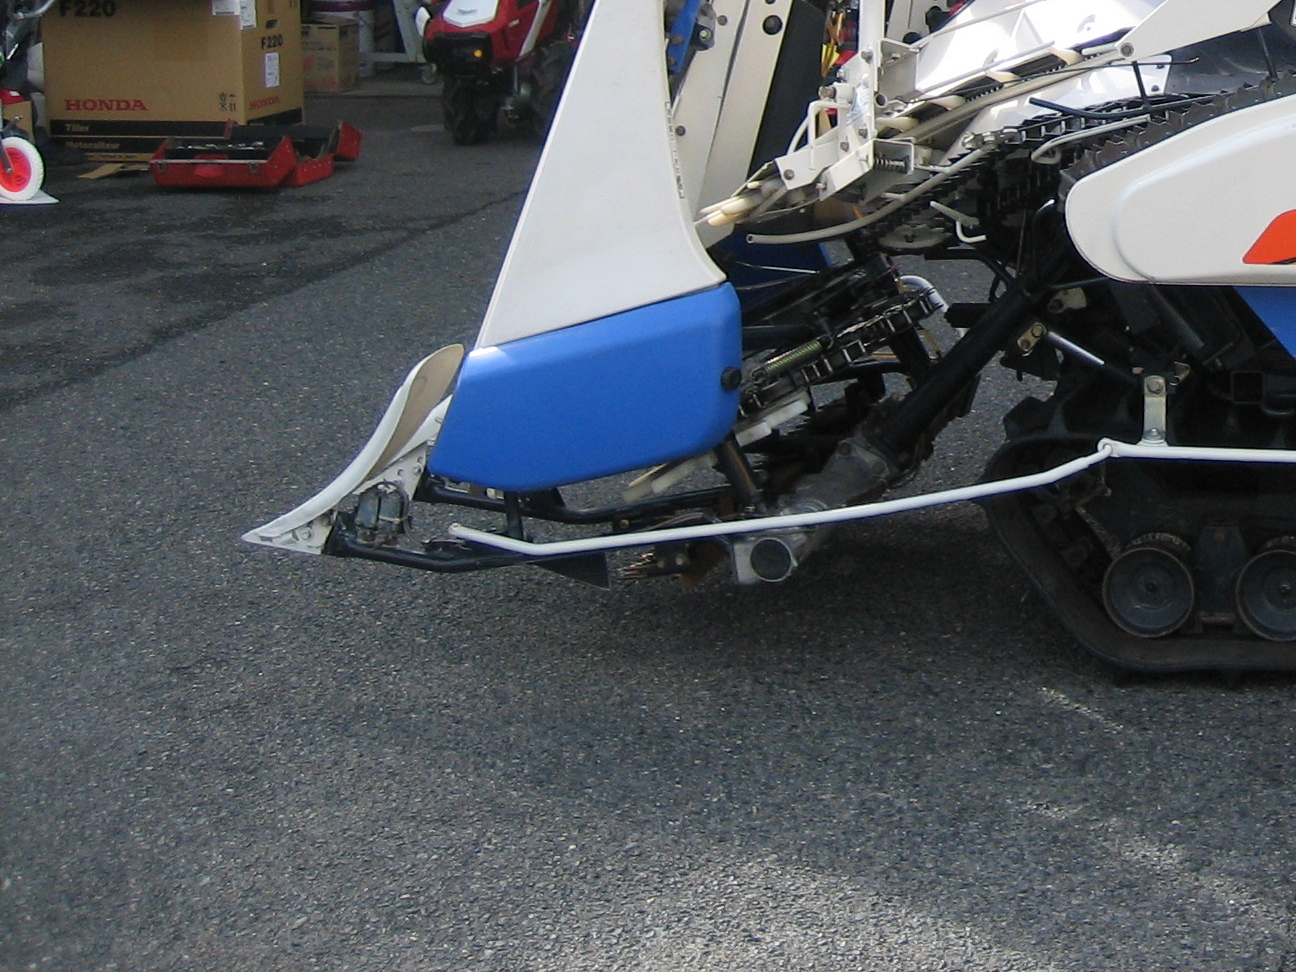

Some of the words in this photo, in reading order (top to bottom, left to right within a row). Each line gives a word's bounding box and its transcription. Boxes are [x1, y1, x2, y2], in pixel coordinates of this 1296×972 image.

[59, 0, 117, 17] F220
[261, 34, 284, 50] F220
[64, 99, 149, 112] HONDA
[250, 95, 281, 111] HONDA
